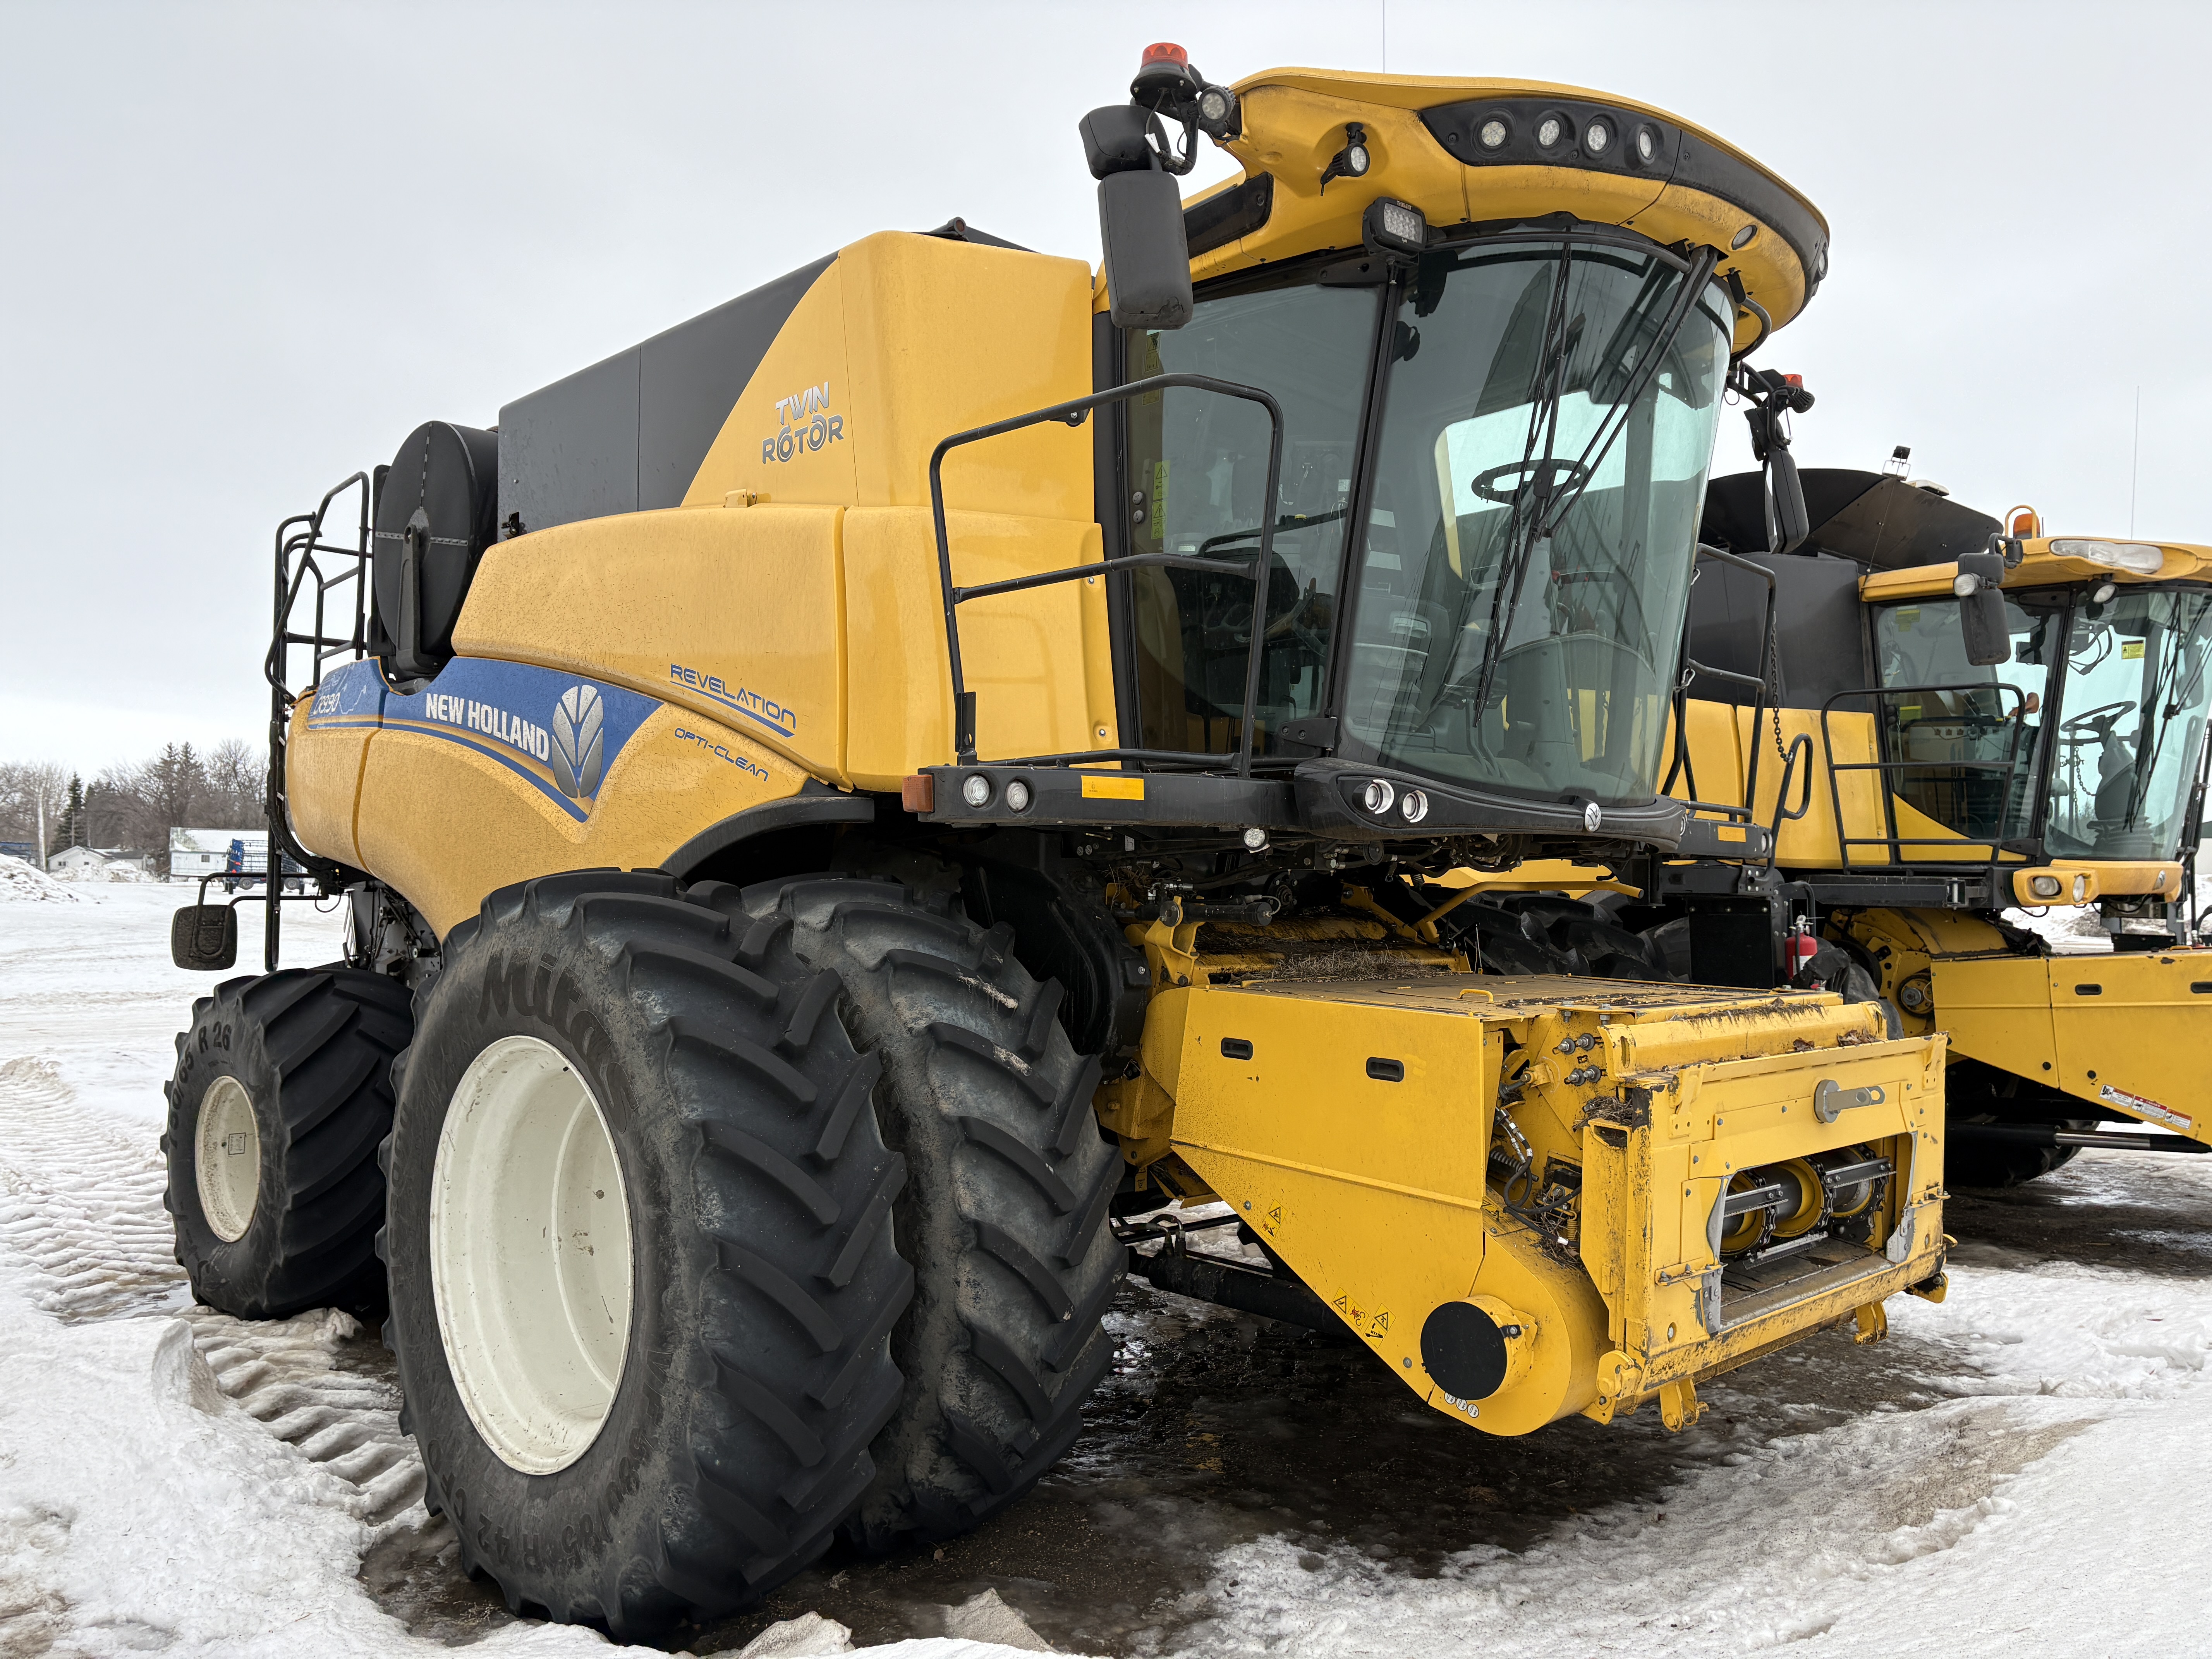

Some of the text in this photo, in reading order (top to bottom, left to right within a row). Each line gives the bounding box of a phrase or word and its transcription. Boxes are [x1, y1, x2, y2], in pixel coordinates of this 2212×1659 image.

[775, 381, 829, 425] TWIN
[762, 413, 844, 465] ROTOR
[670, 663, 796, 730] REVELATION
[426, 693, 549, 761] NEW HOLLAND
[674, 727, 769, 782] OPTI-CLEAN
[198, 1025, 208, 1054] R
[213, 1021, 232, 1051] 26
